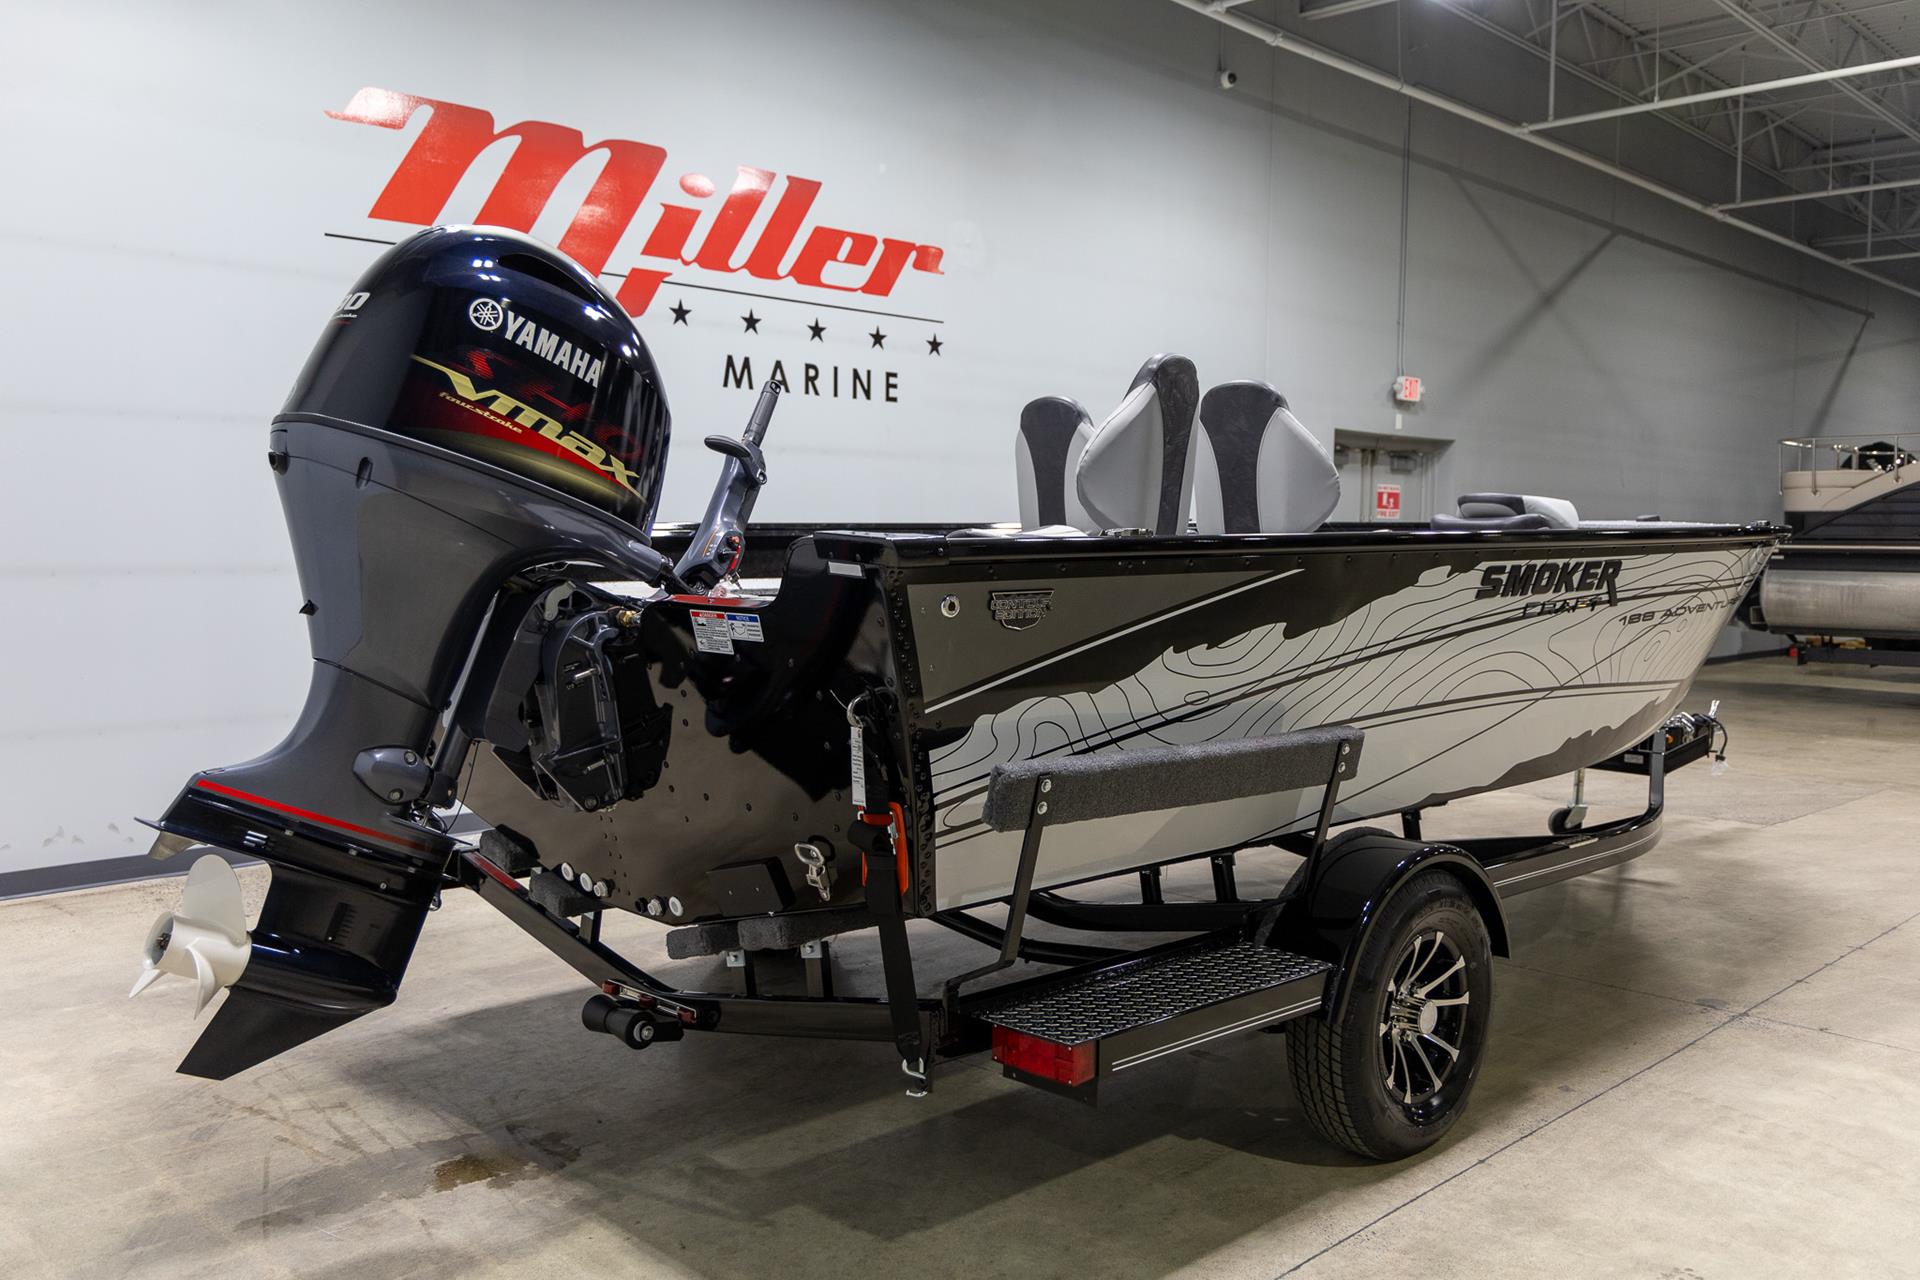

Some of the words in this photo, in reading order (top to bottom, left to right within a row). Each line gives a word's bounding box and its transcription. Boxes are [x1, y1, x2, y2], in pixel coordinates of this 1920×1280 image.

[324, 86, 945, 318] Miller
[503, 310, 604, 388] YAMAHA
[722, 353, 899, 403] MARINE
[1475, 559, 1623, 607] SMOKER
[1619, 611, 1656, 626] 188
